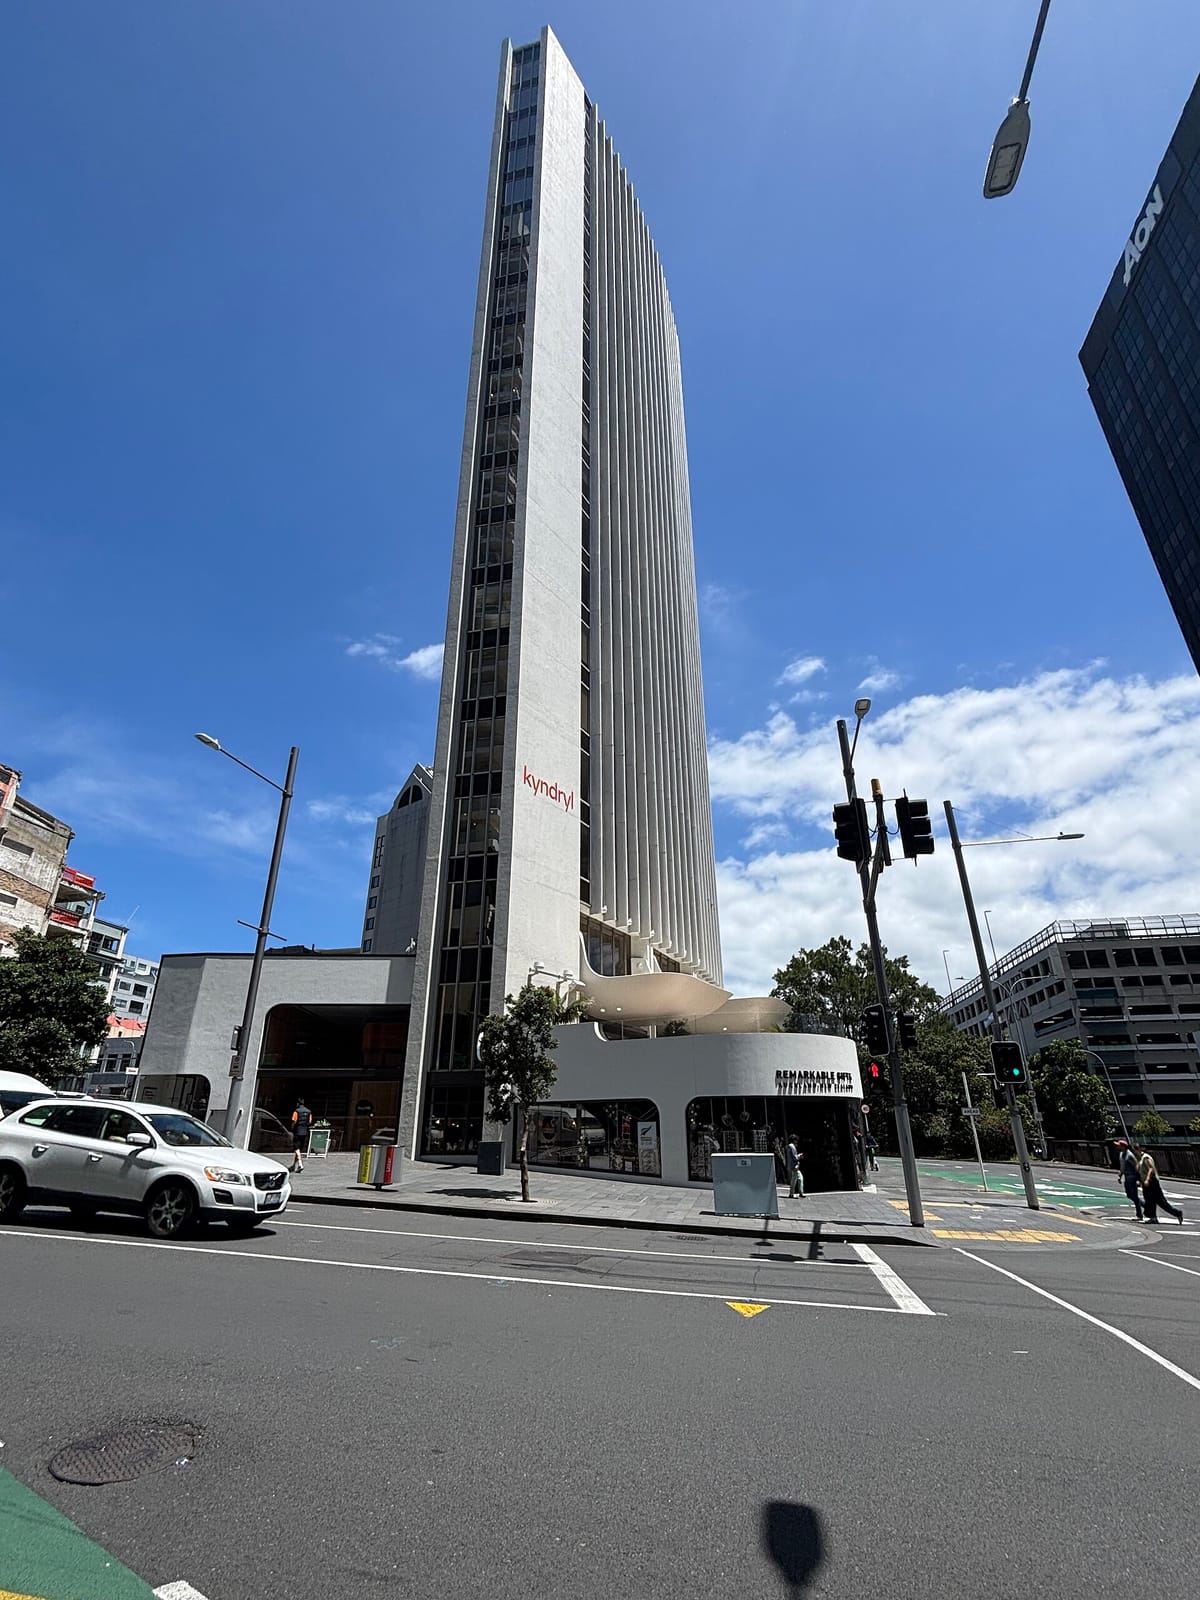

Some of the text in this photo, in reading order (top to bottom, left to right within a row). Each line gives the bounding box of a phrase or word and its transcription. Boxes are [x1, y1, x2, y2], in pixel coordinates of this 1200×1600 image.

[1123, 183, 1163, 287] AON
[523, 765, 574, 812] kyndryl
[776, 1070, 835, 1080] REMARKABLE
